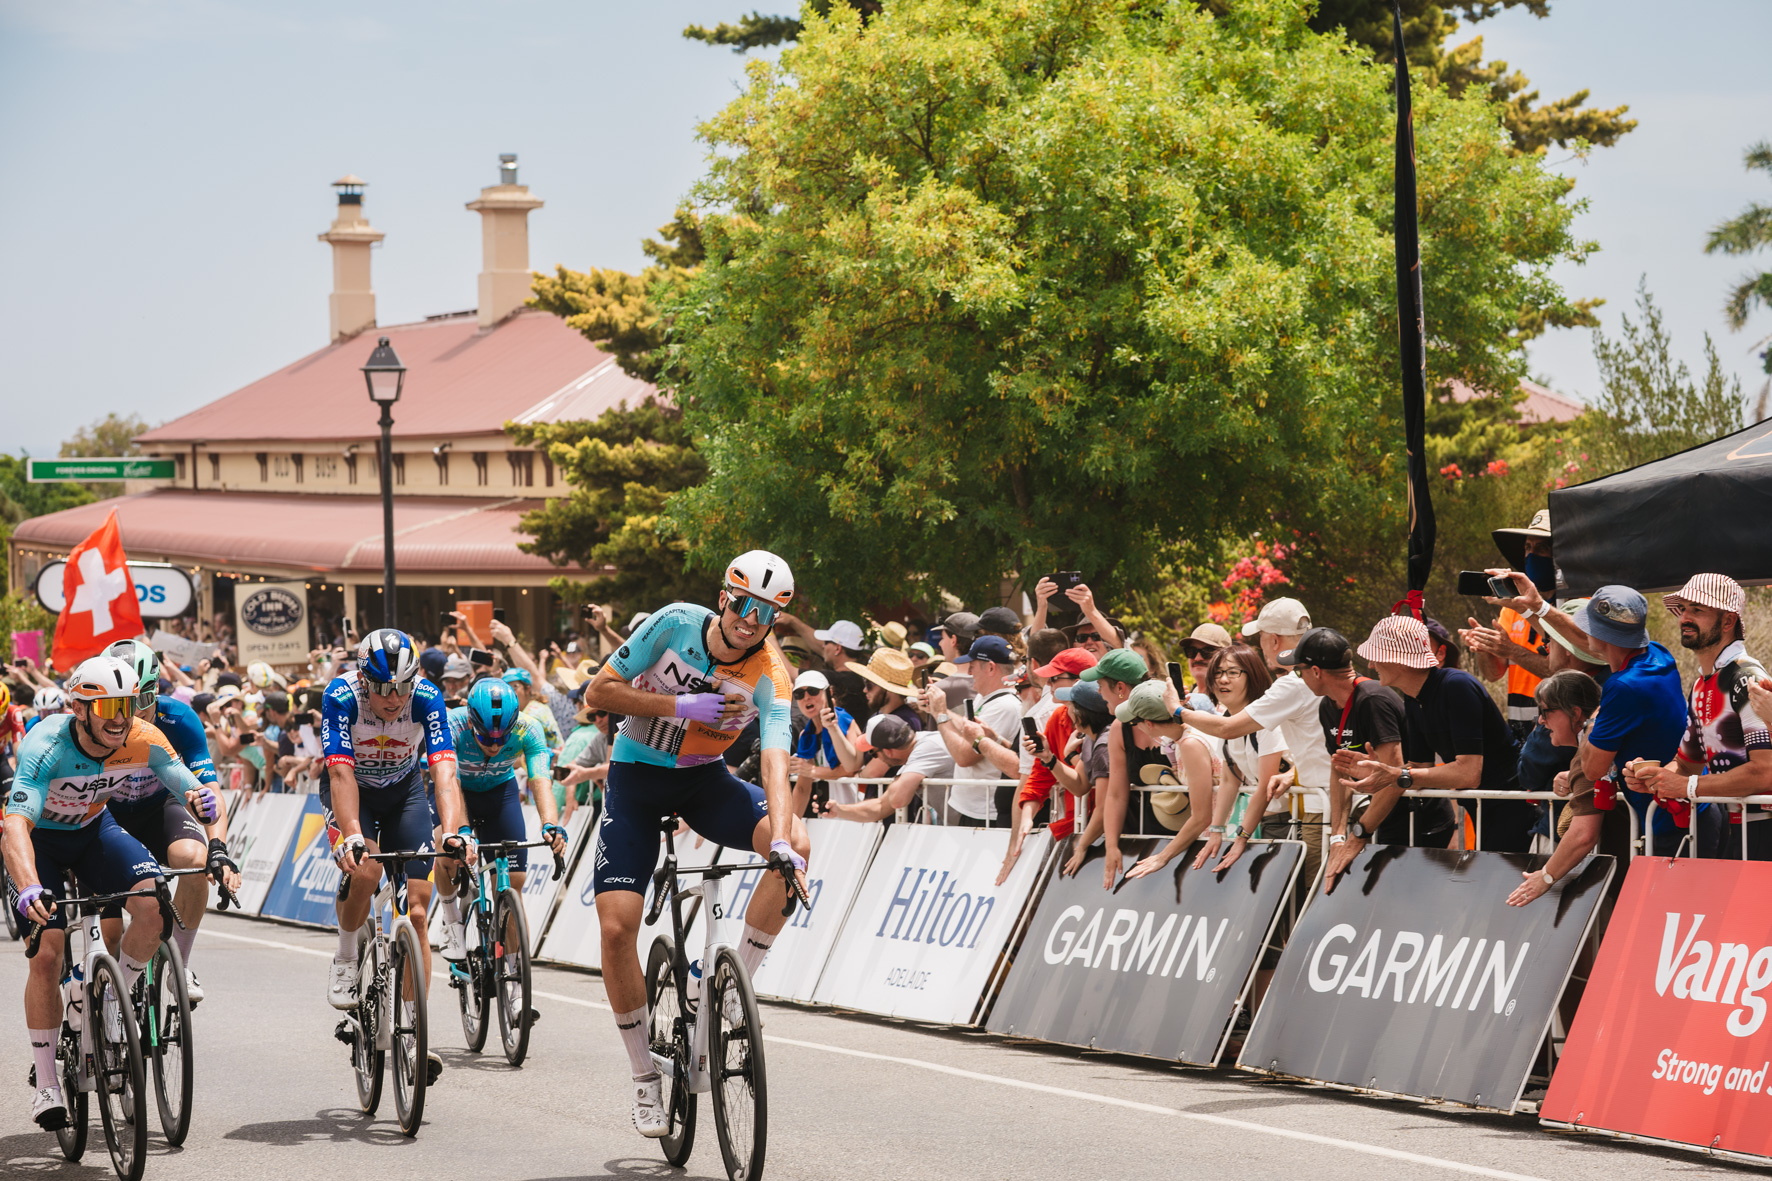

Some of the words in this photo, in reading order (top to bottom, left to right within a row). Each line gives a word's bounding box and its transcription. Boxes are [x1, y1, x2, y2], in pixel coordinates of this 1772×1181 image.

[247, 593, 267, 612] OLD
[262, 602, 283, 612] INN
[641, 625, 655, 642] PEACE
[654, 615, 666, 628] PARK
[665, 608, 687, 617] CAPITAL
[246, 644, 269, 652] OPEN
[271, 642, 276, 650] 7
[278, 641, 301, 649] DAYS
[330, 685, 351, 698] BORA
[418, 683, 439, 696] BORA
[321, 718, 331, 750] BORA
[338, 715, 352, 750] BOSS
[363, 718, 376, 727] BOSS
[426, 710, 444, 746] BOSS
[355, 751, 380, 759] ed
[132, 861, 157, 870] RACING
[875, 867, 996, 949] Hilton
[1043, 904, 1229, 982] GARMIN
[884, 967, 931, 990] ADELAIDE
[1308, 923, 1530, 1016] GARMIN
[1654, 912, 1772, 1037] Vang
[1652, 1048, 1724, 1095] Strong
[1724, 1062, 1769, 1093] and
